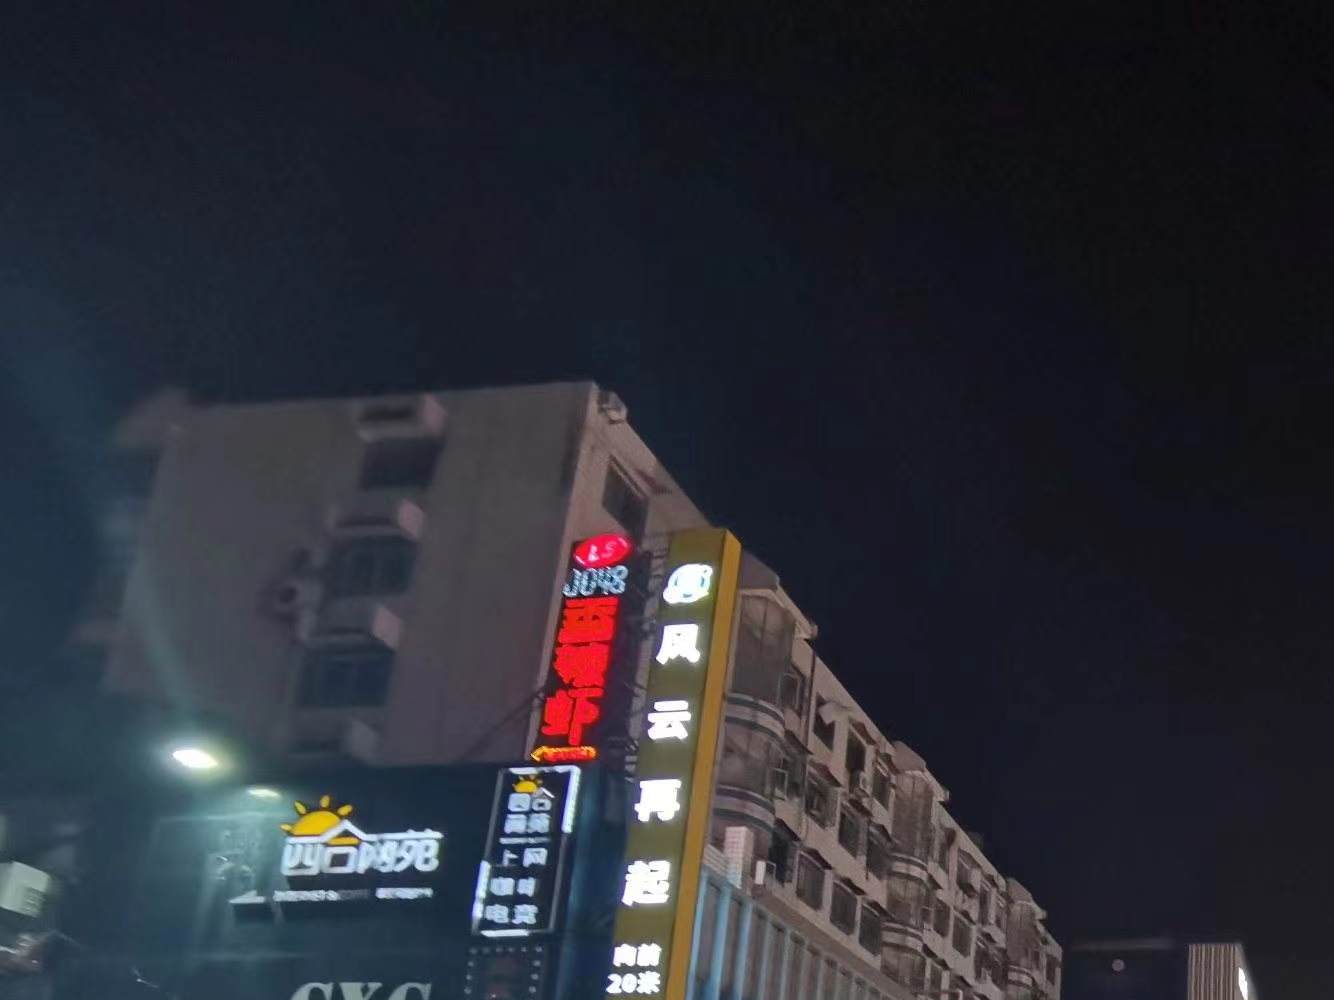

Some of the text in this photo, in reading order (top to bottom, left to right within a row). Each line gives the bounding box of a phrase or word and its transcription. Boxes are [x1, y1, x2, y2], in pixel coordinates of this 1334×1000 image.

[621, 623, 701, 907] 风云再起
[606, 971, 661, 995] 20米
